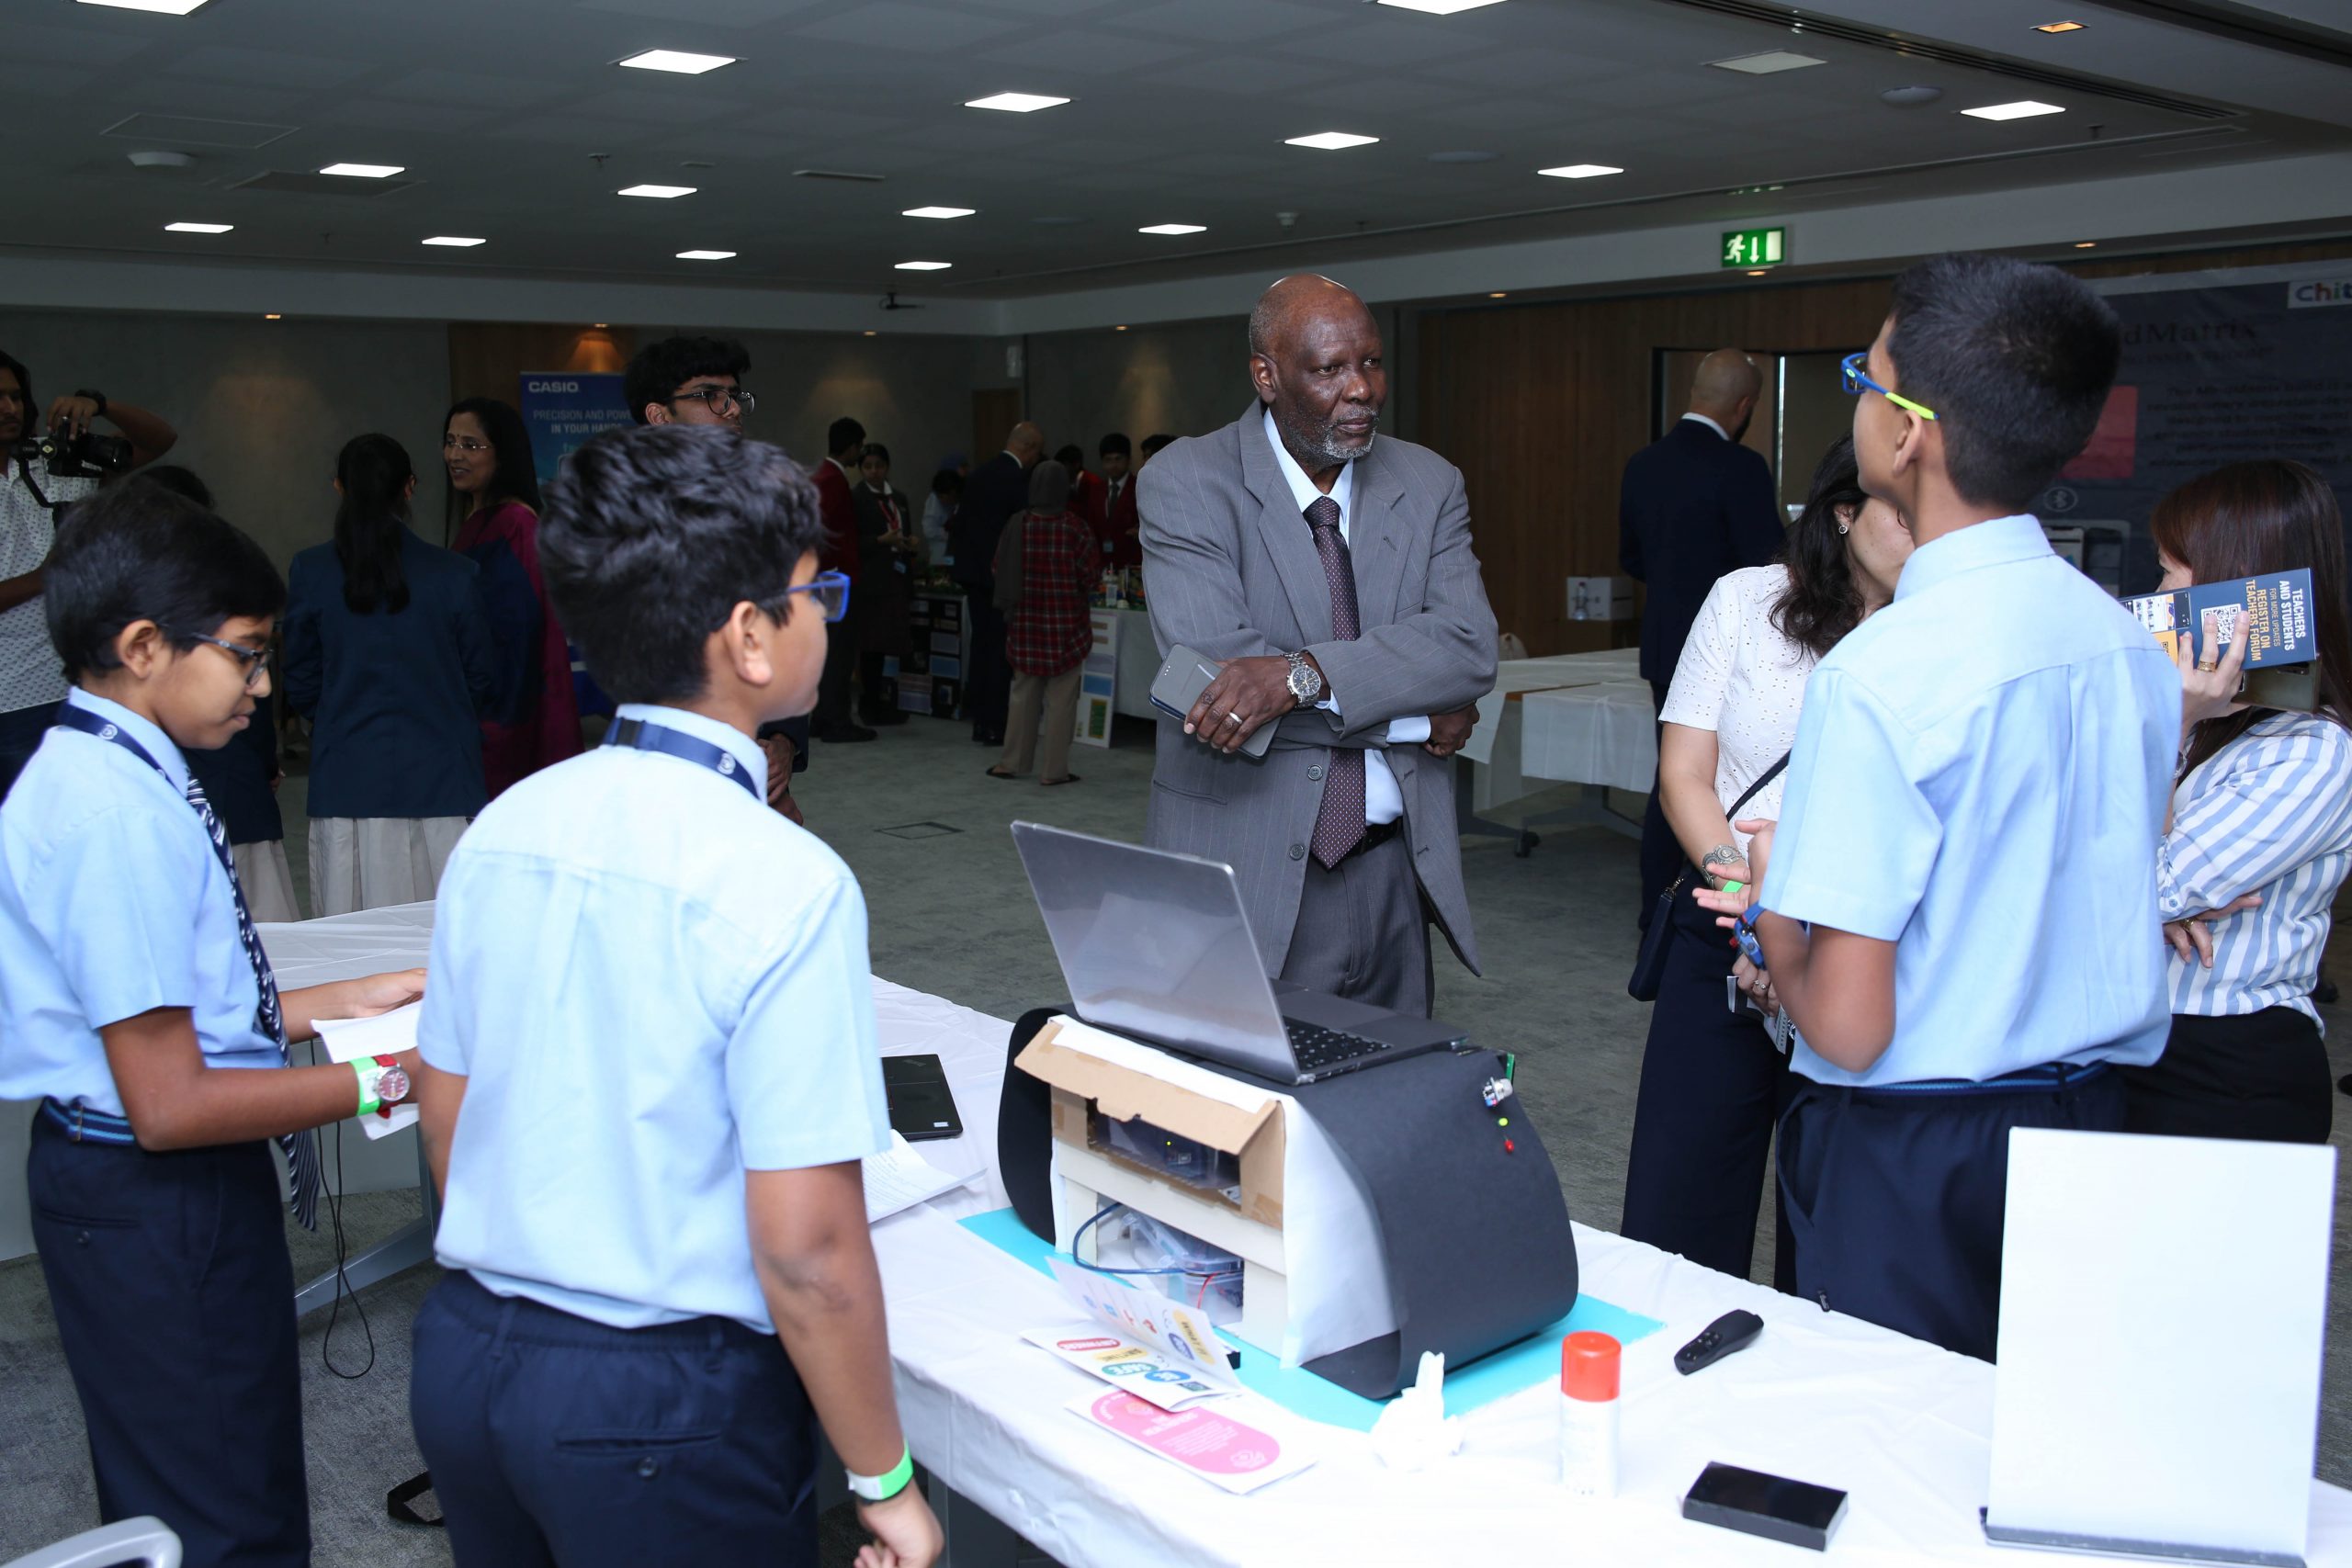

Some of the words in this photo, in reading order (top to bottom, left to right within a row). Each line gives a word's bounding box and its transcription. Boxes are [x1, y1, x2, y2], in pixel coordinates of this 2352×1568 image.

[527, 381, 580, 393] CASIO
[533, 410, 582, 421] PRECISION
[584, 410, 604, 421] AND
[551, 423, 561, 434] IN
[563, 423, 589, 434] YOUR
[2269, 588, 2278, 600] FOR
[2278, 580, 2291, 600] AND
[2245, 579, 2258, 626] TEACHERS
[2256, 589, 2269, 633] REGISTER
[2270, 601, 2279, 618] MORE
[2291, 588, 2306, 638] TEACHERS
[2271, 619, 2280, 647] UPDATES
[2280, 602, 2295, 651] STUDENTS
[2248, 627, 2262, 661] FORUM
[2260, 636, 2271, 649] ON
